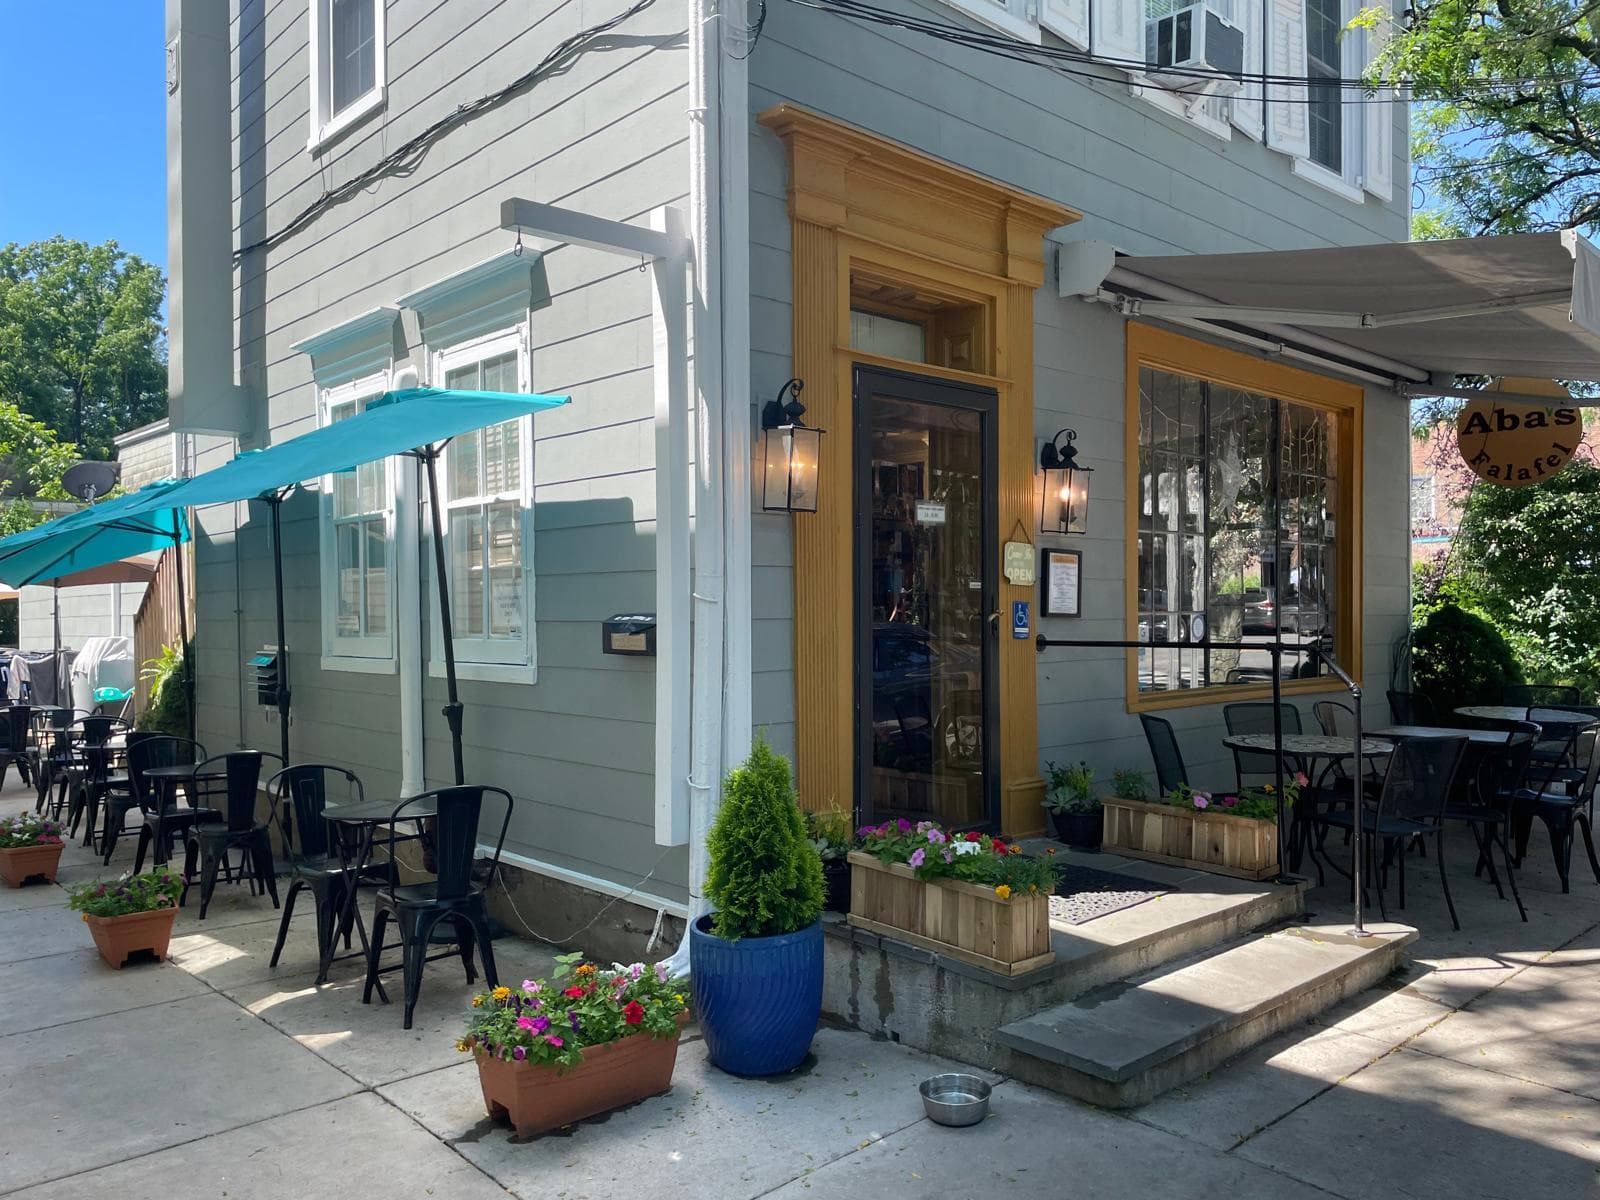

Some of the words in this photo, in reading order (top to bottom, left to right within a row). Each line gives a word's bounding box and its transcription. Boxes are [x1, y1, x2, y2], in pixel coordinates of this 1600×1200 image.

[1462, 407, 1577, 435] Aba's
[1470, 442, 1572, 481] Falafel
[1007, 567, 1032, 582] OPEN
